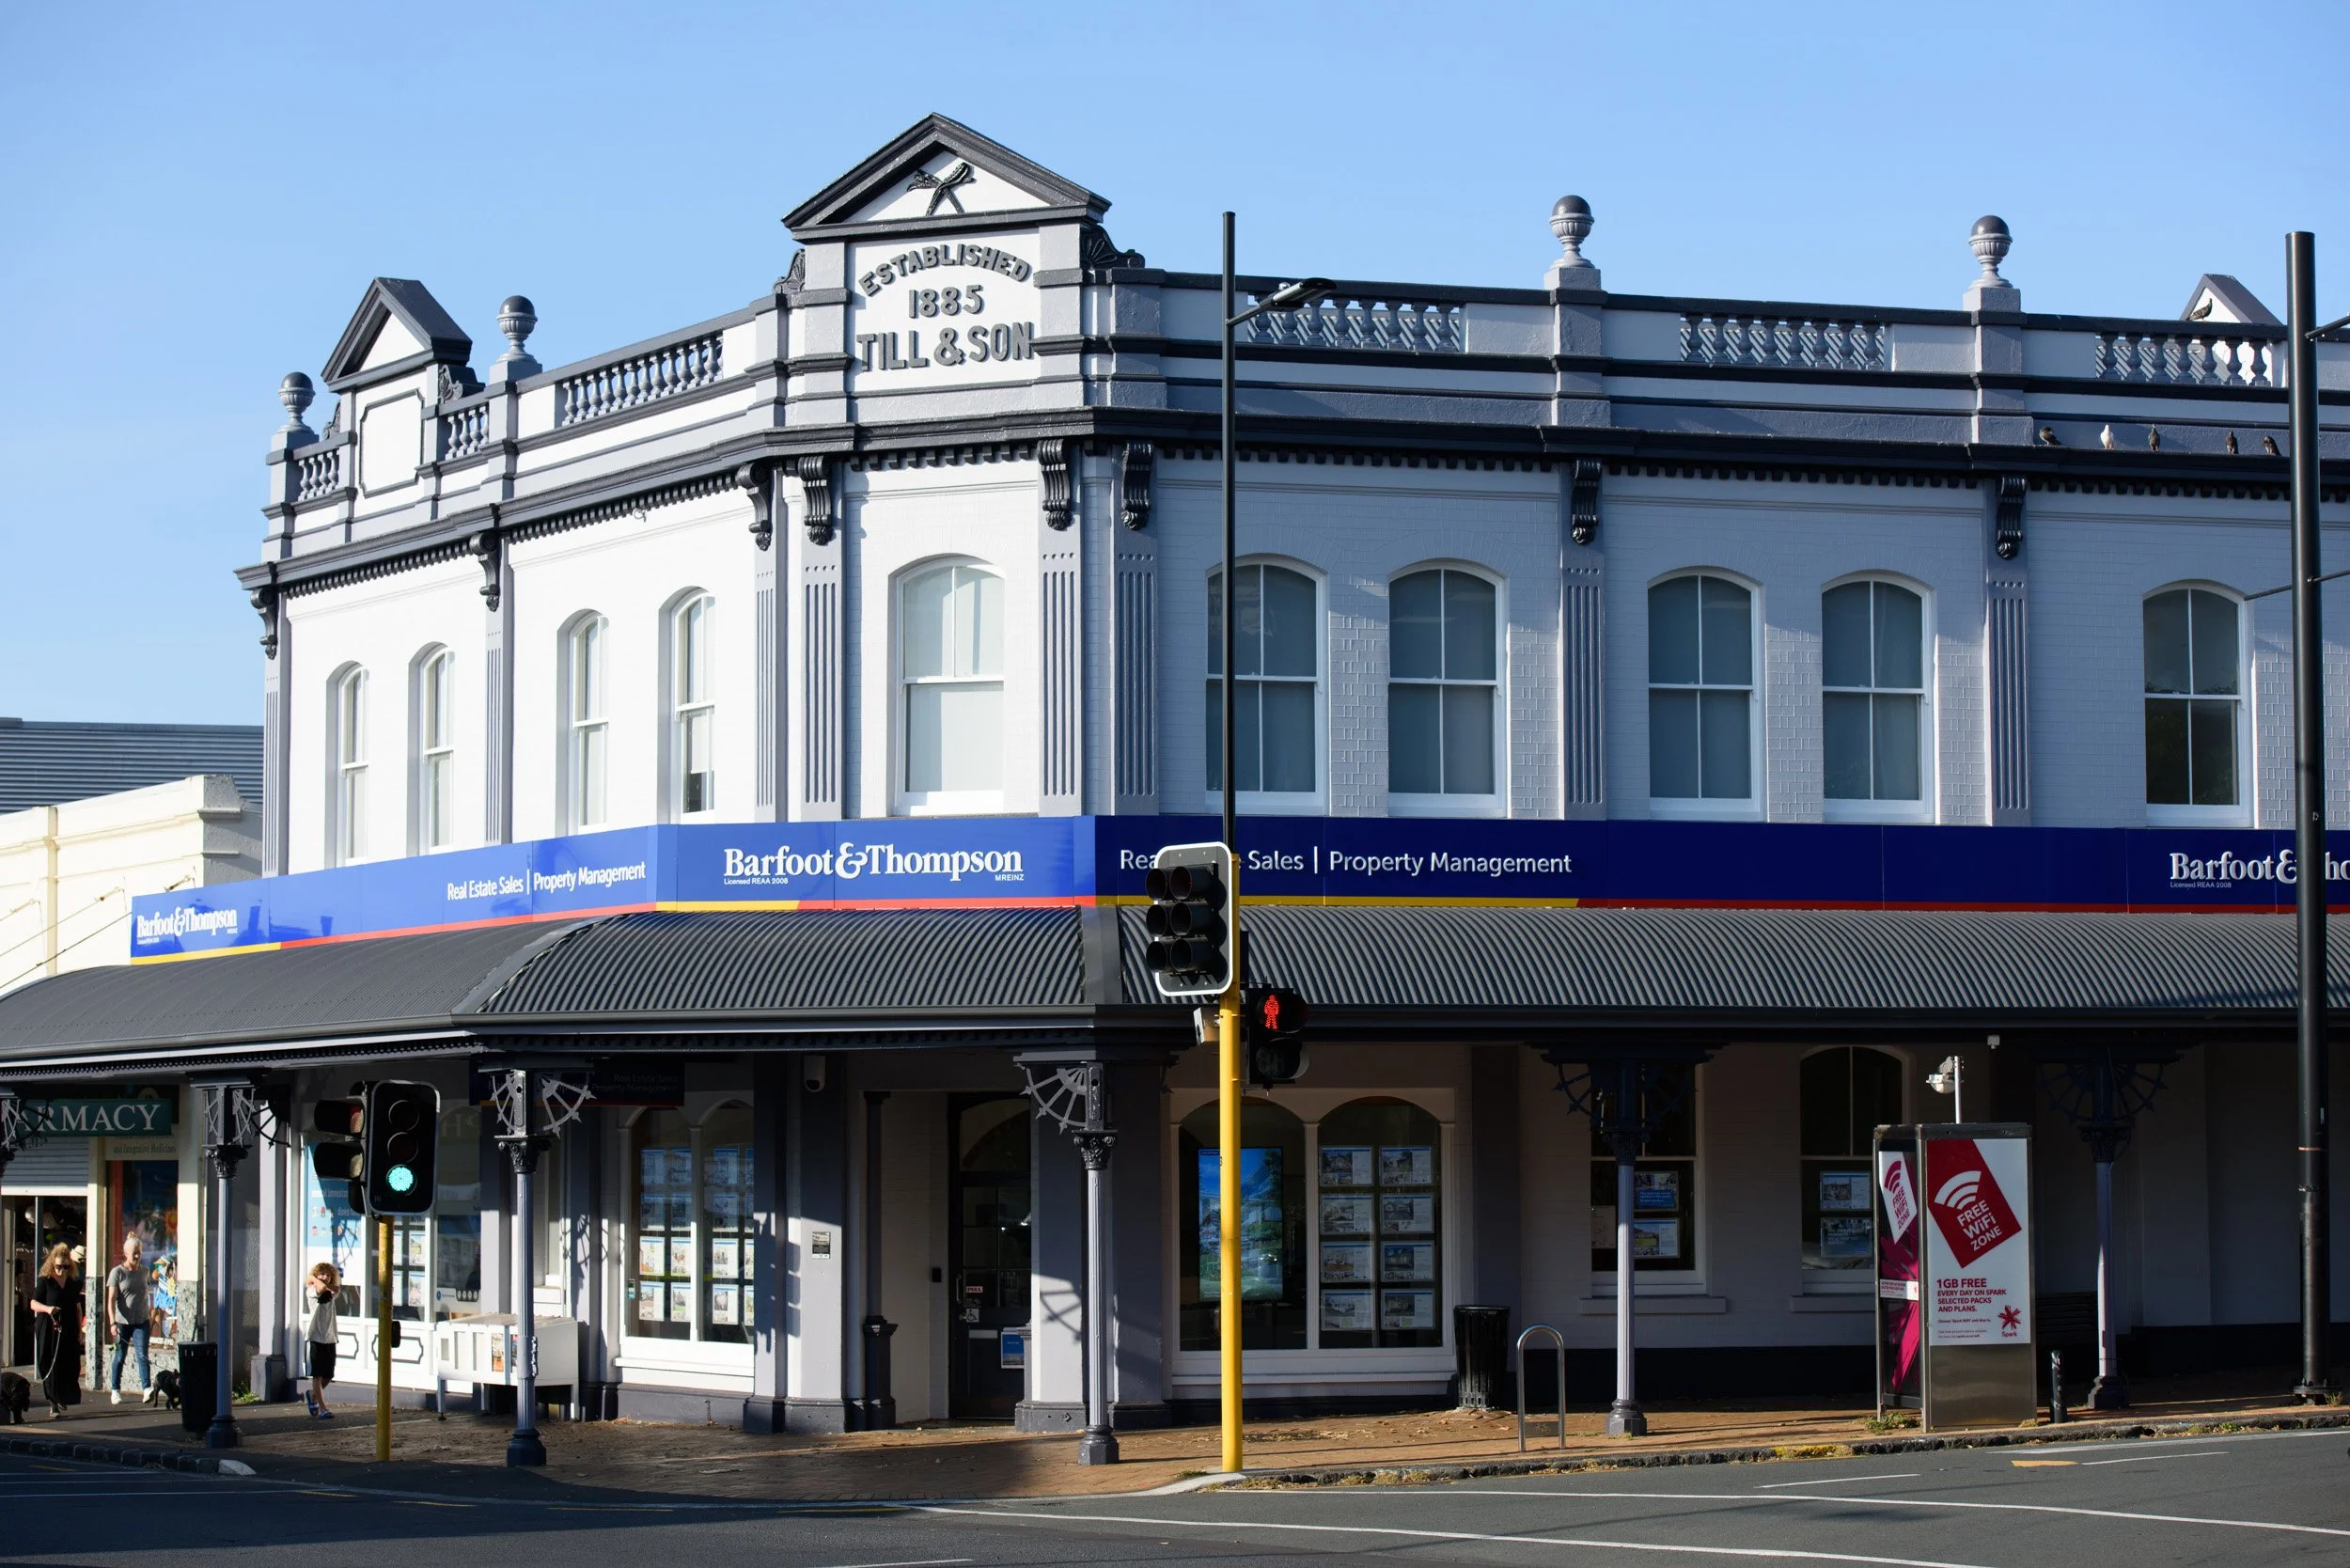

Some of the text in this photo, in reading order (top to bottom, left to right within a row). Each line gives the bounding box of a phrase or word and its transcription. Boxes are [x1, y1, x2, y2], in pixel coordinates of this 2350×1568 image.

[858, 243, 1032, 297] ESTABLISHED
[908, 284, 983, 318] 1885
[856, 321, 1035, 371] TILL & SON
[1120, 849, 1155, 870] Rea
[1248, 850, 1304, 870] Sales
[1330, 850, 1424, 876] Property
[1431, 852, 1572, 877] Management
[447, 861, 646, 901] Real Estate Sales Property Management
[724, 877, 750, 886] Licensed
[14, 1105, 162, 1133] ARMACY
[1893, 1188, 1905, 1209] FREE
[1898, 1210, 1910, 1231] ZONE
[1957, 1200, 1990, 1227] FREE
[1963, 1212, 1997, 1239] WiFi
[1970, 1225, 2002, 1251] ZONE
[1936, 1278, 1987, 1288] 1GB FREE
